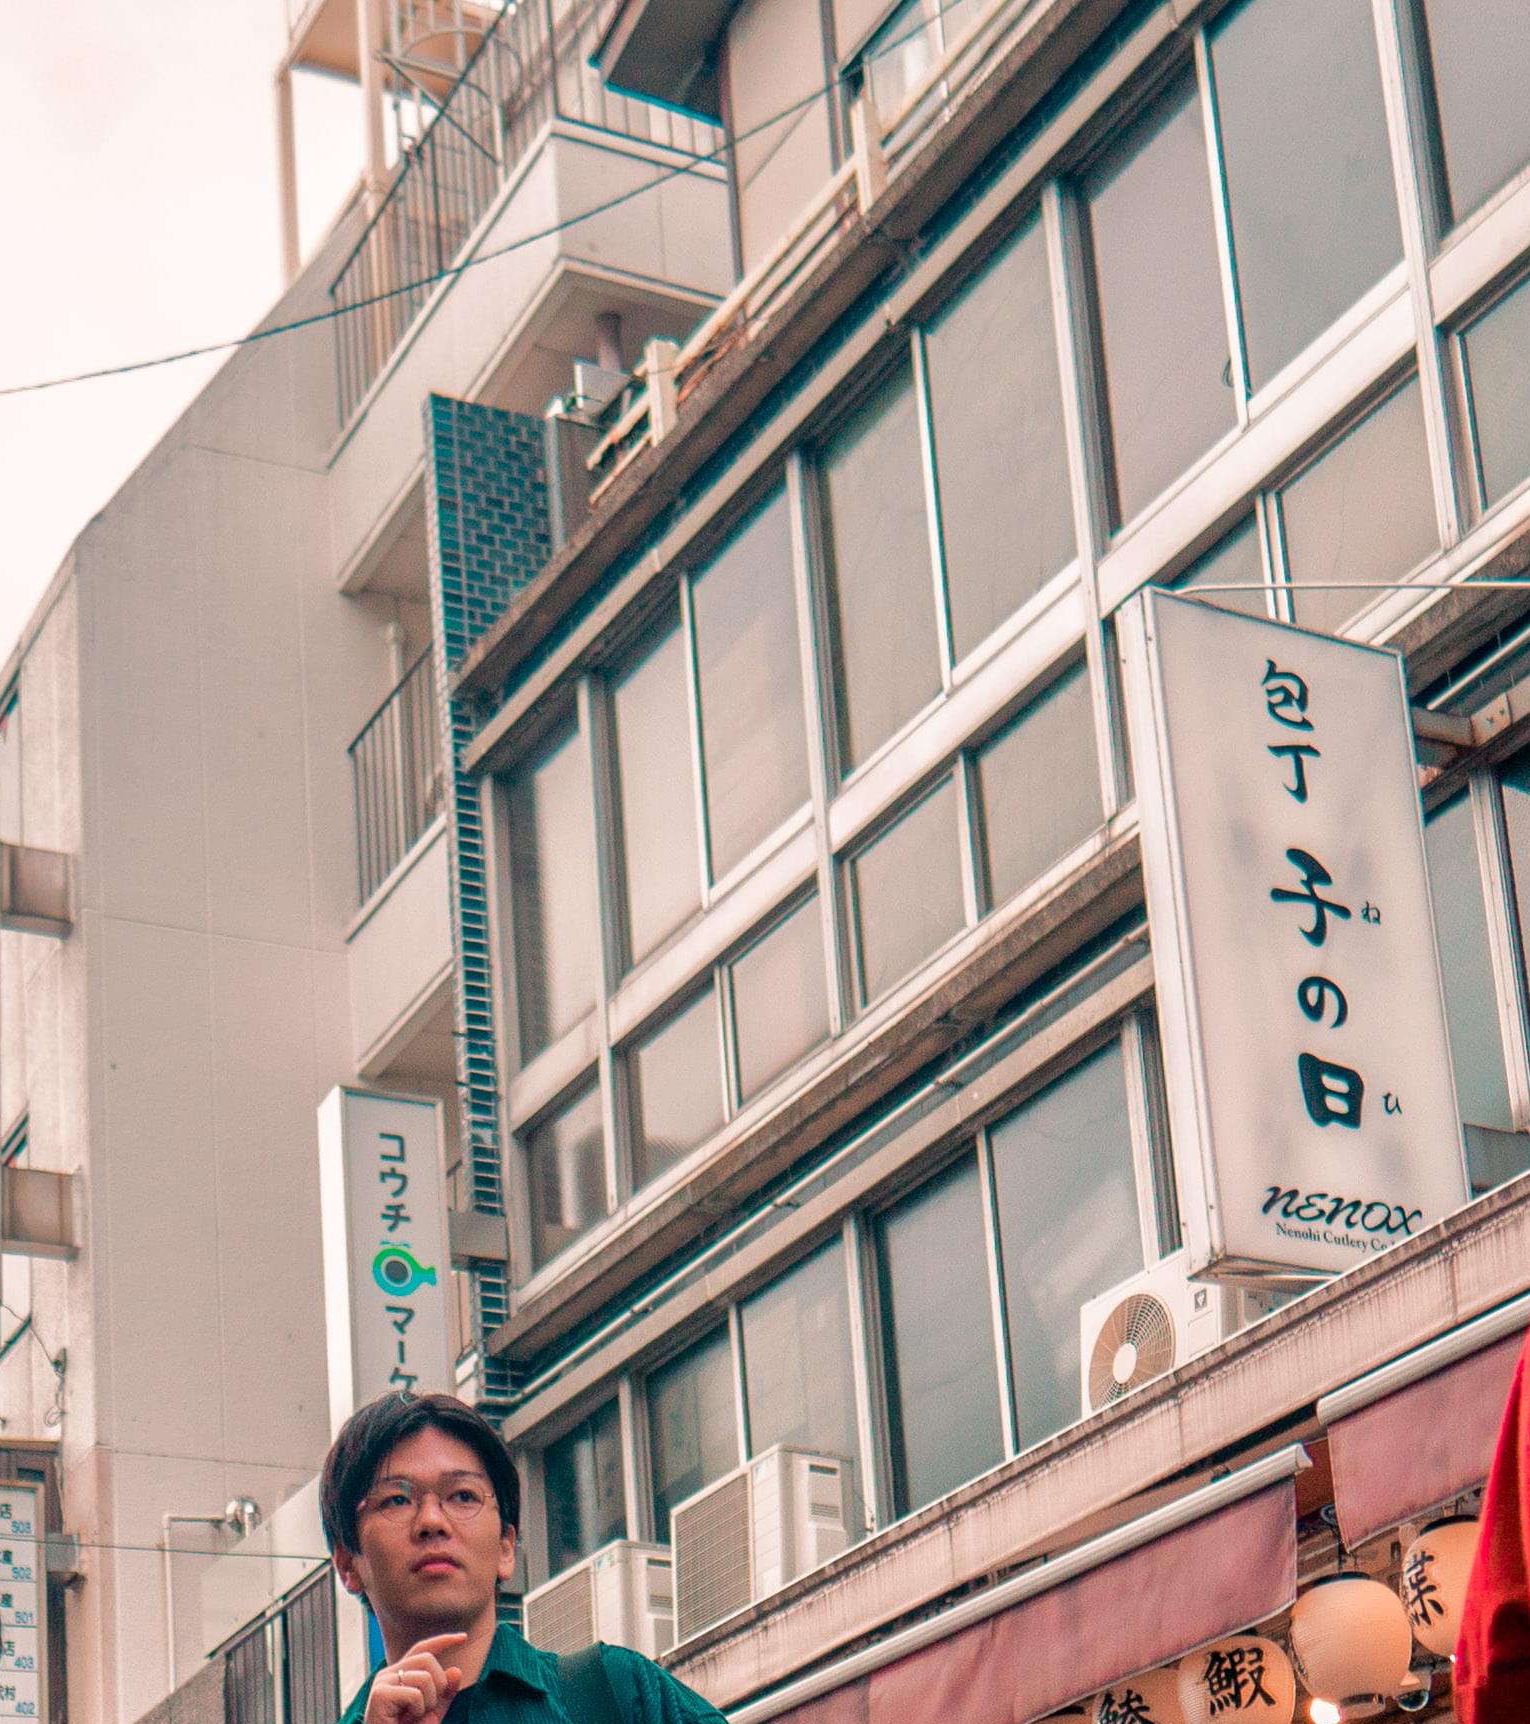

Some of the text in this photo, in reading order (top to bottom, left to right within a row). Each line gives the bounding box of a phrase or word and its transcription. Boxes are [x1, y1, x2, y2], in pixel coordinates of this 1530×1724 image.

[378, 1132, 412, 1232] コウチ
[1275, 1221, 1320, 1242] Nenohi
[1323, 1231, 1368, 1253] Cutlery
[12, 1566, 32, 1580] 502
[14, 1610, 34, 1624] 501
[14, 1656, 34, 1669] 403
[15, 1702, 35, 1715] 402
